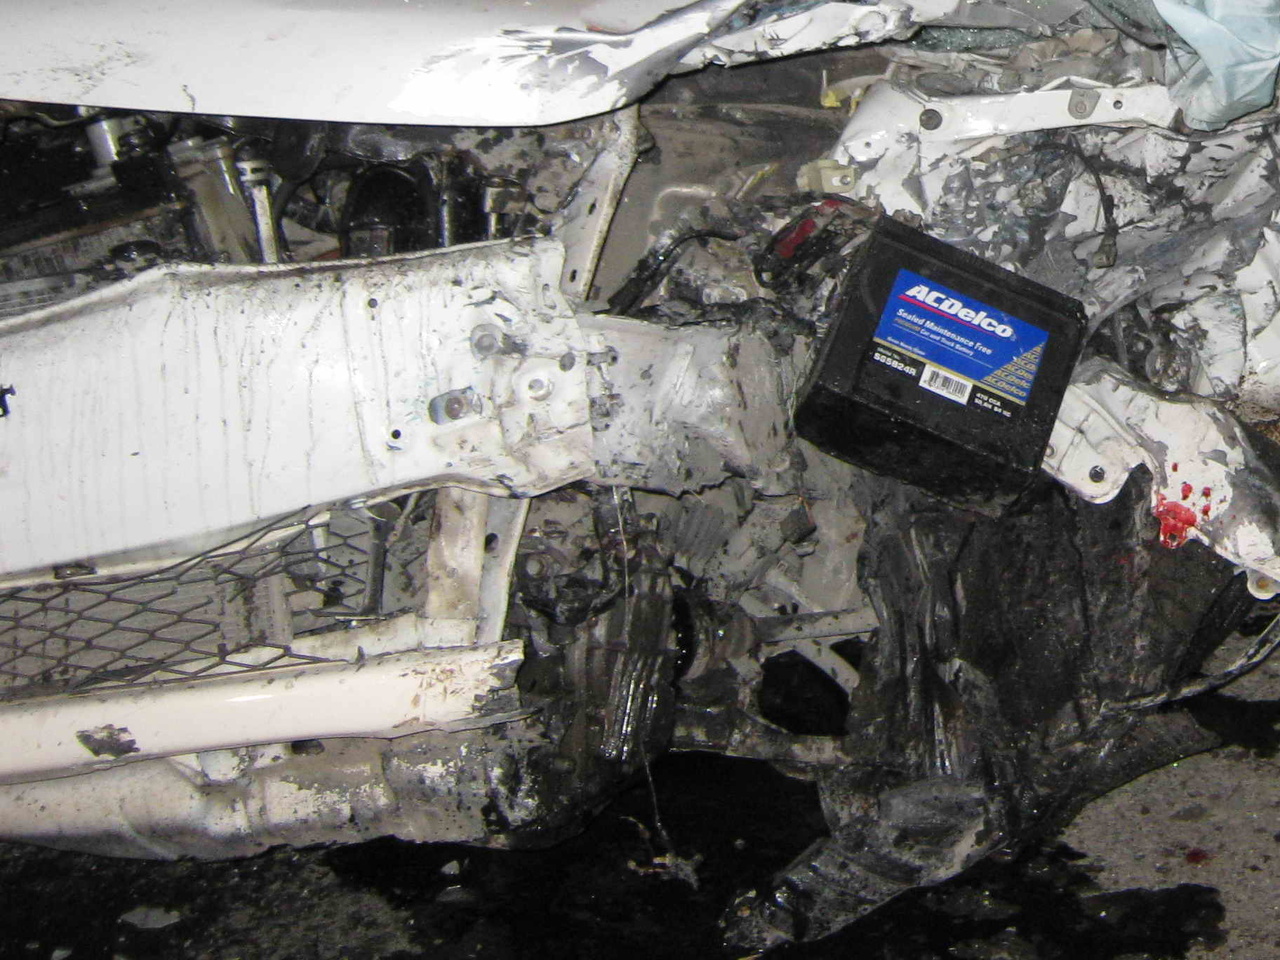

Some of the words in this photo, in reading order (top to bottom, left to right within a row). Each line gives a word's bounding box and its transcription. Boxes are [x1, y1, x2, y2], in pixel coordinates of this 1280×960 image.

[896, 308, 924, 326] Sealed
[923, 320, 974, 347] Maintenance
[974, 342, 993, 356] Free
[904, 283, 1015, 338] ACDelco
